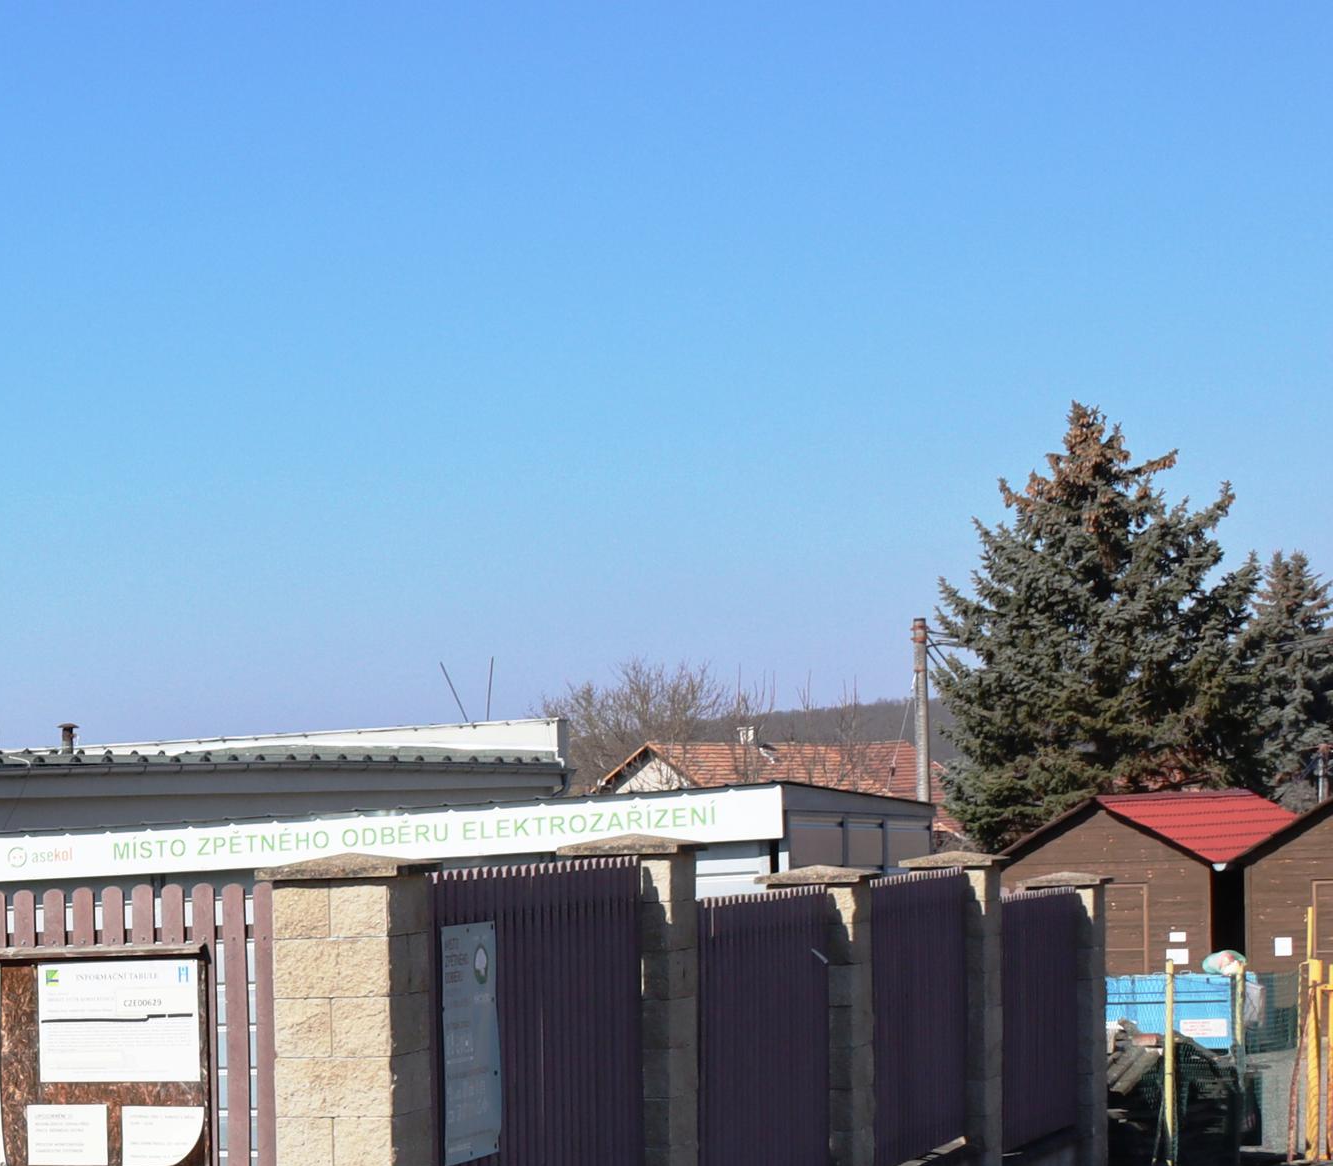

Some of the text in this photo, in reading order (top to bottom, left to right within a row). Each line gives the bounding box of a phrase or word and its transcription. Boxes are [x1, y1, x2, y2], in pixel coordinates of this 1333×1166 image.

[113, 800, 717, 860] MÍSTO ZPĚTNÉHO ODBĚRU ELEKTROZAŘÍZENÍ
[31, 846, 73, 864] asekol
